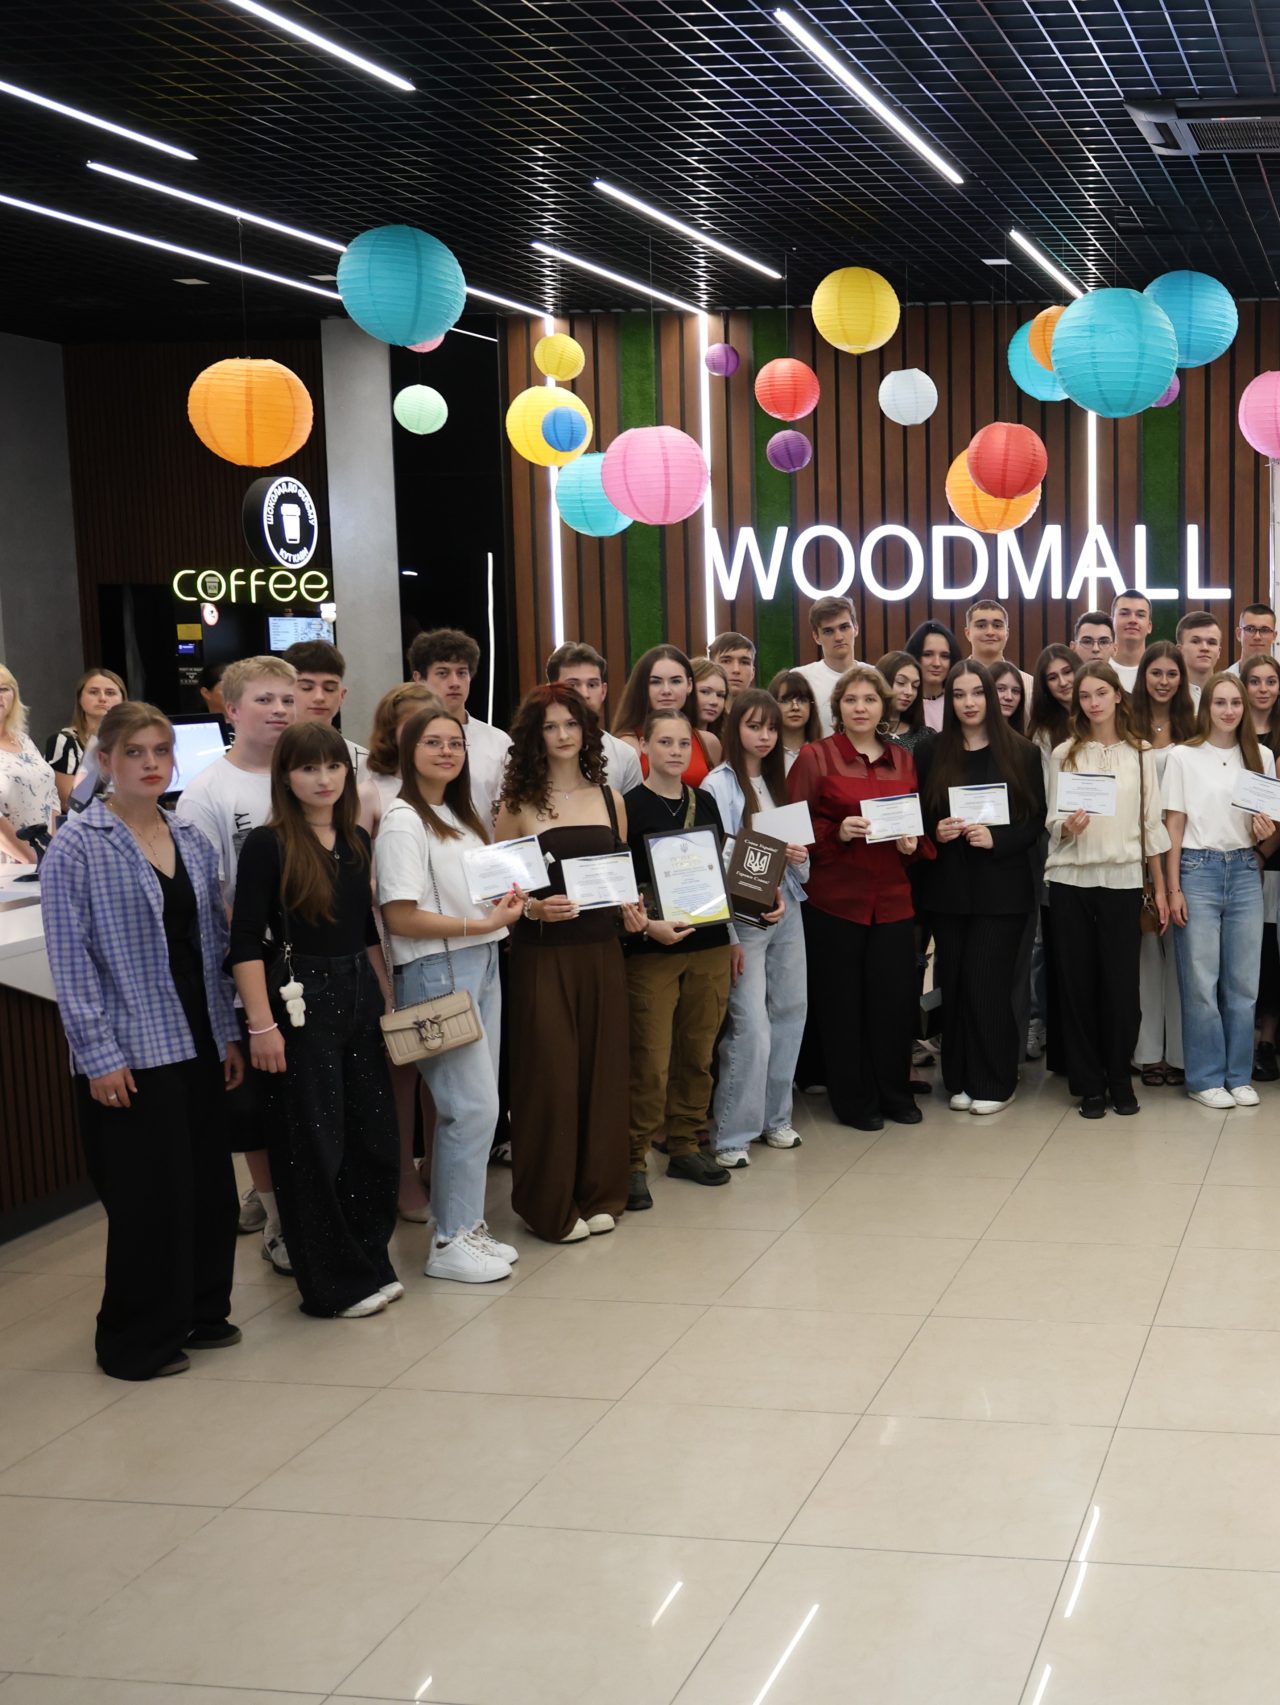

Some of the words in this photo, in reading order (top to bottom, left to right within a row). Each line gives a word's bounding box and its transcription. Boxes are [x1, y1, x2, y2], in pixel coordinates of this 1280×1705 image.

[710, 524, 1232, 600] WOODMALL
[172, 568, 330, 604] coffee
[234, 812, 253, 833] ITY
